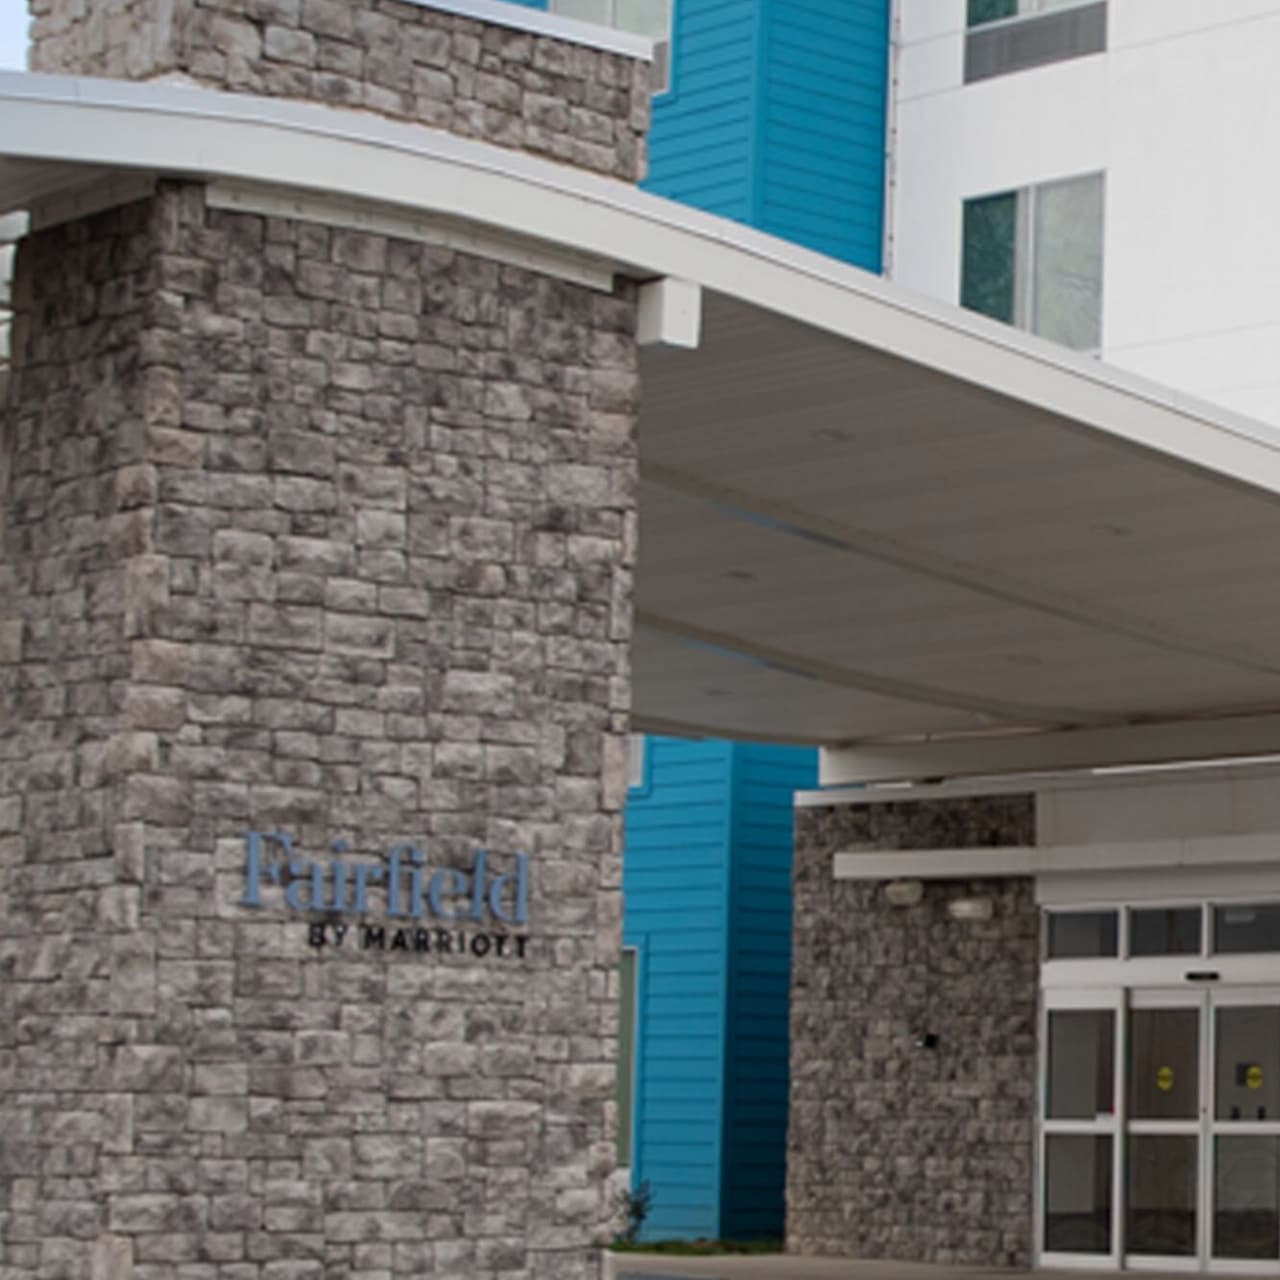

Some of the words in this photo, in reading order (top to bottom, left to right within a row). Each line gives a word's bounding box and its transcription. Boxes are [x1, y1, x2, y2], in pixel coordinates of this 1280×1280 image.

[241, 829, 529, 924] Fairfield
[307, 922, 348, 948] BY
[364, 923, 530, 959] MARRIOTT
